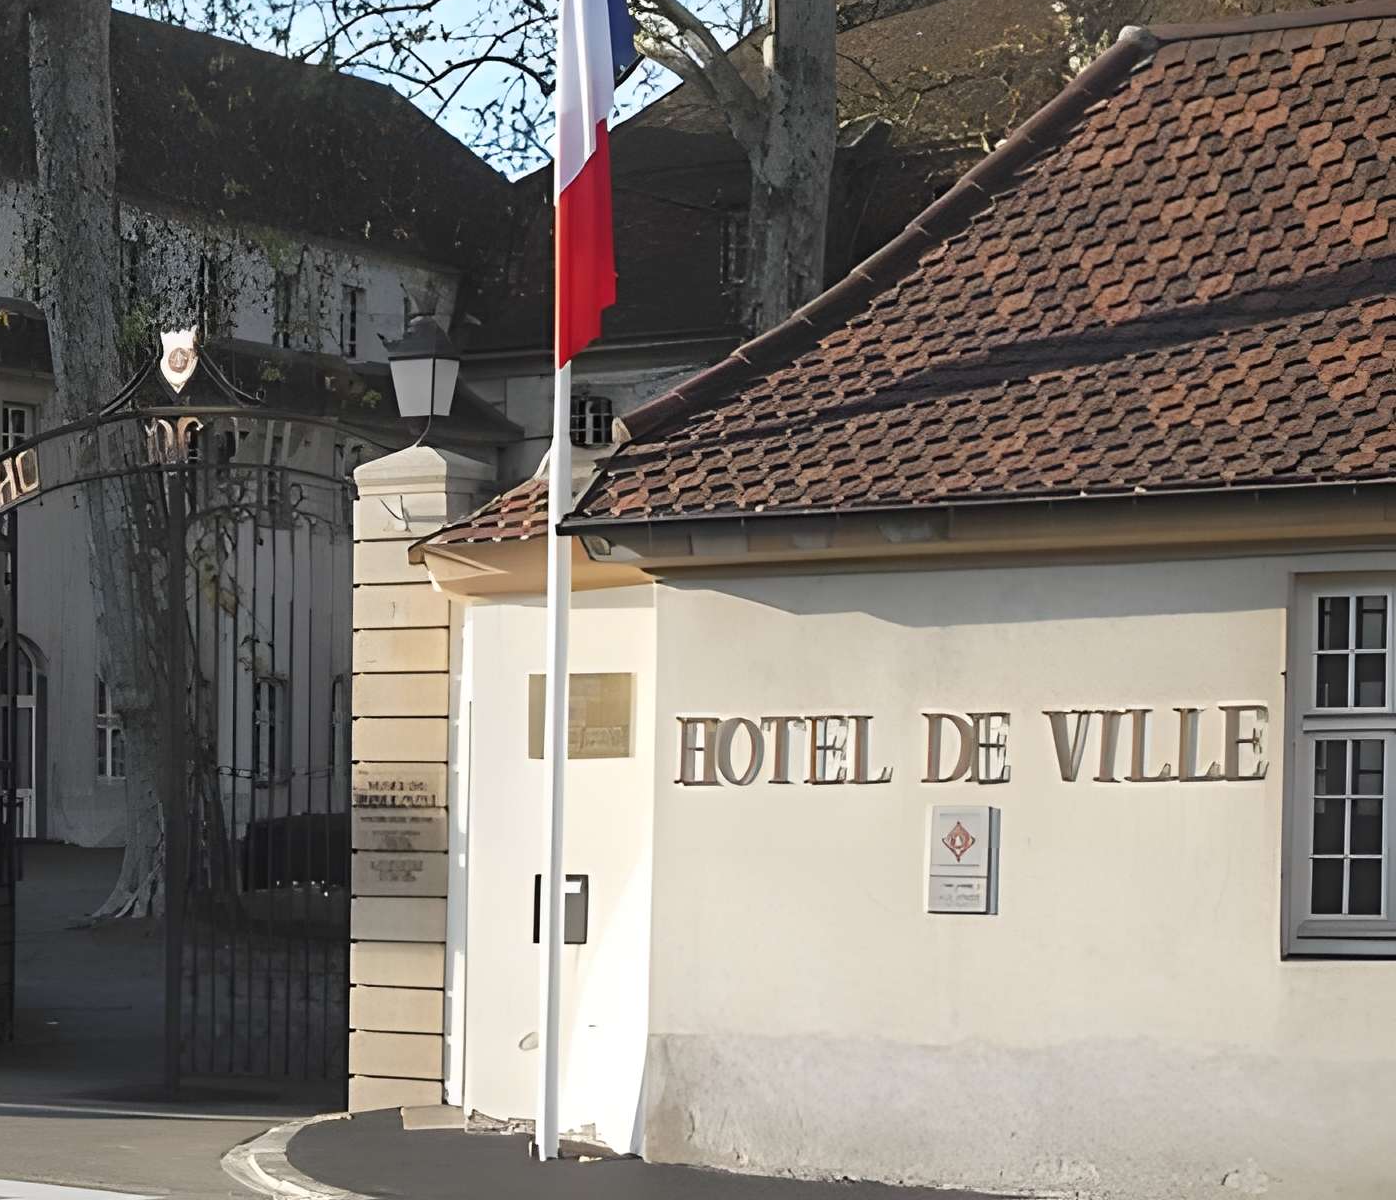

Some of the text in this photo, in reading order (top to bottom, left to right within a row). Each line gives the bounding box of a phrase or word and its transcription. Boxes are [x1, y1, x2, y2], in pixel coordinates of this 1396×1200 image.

[673, 703, 1270, 787] HOTEL DE VILLE
